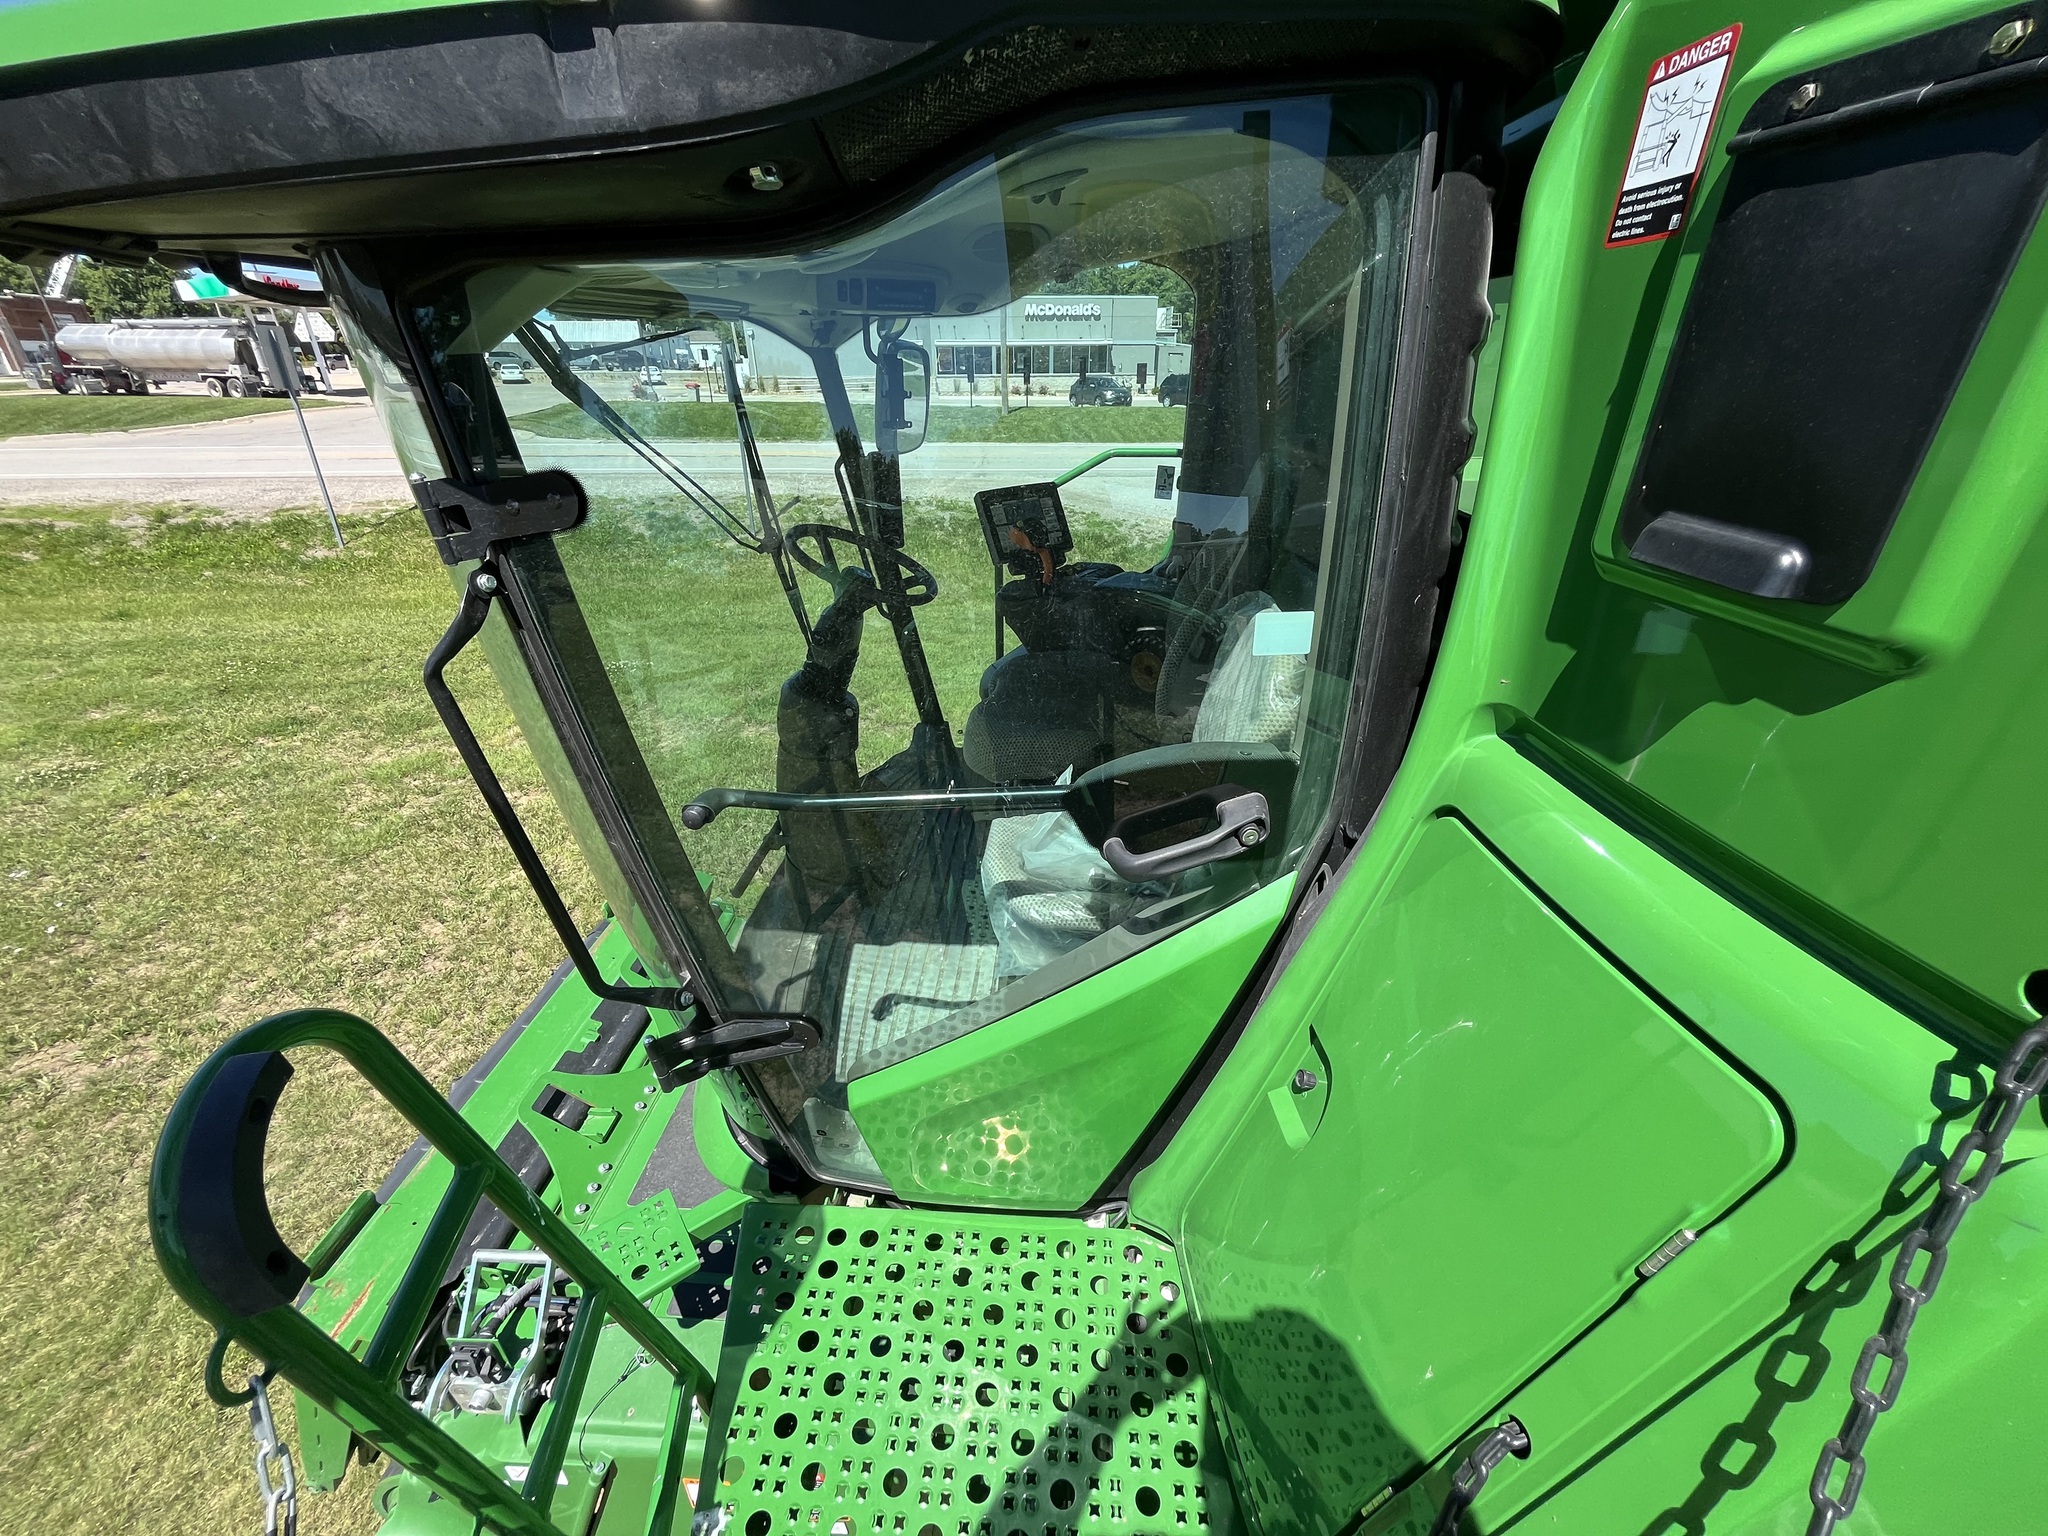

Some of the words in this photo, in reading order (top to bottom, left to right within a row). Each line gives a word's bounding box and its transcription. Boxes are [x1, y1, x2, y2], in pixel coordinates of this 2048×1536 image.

[1668, 31, 1733, 74] DANGER
[1621, 193, 1637, 203] Avoid
[1637, 189, 1657, 199] serious
[1657, 185, 1674, 195] injury
[1618, 206, 1633, 215] death
[1633, 203, 1646, 212] from
[1646, 195, 1683, 208] electrocution.
[1615, 219, 1623, 227] Do
[1623, 217, 1632, 225] not
[1632, 213, 1653, 223] contact
[1612, 230, 1630, 238] electric
[1630, 227, 1644, 235] lines.
[1024, 303, 1102, 316] McDonald's
